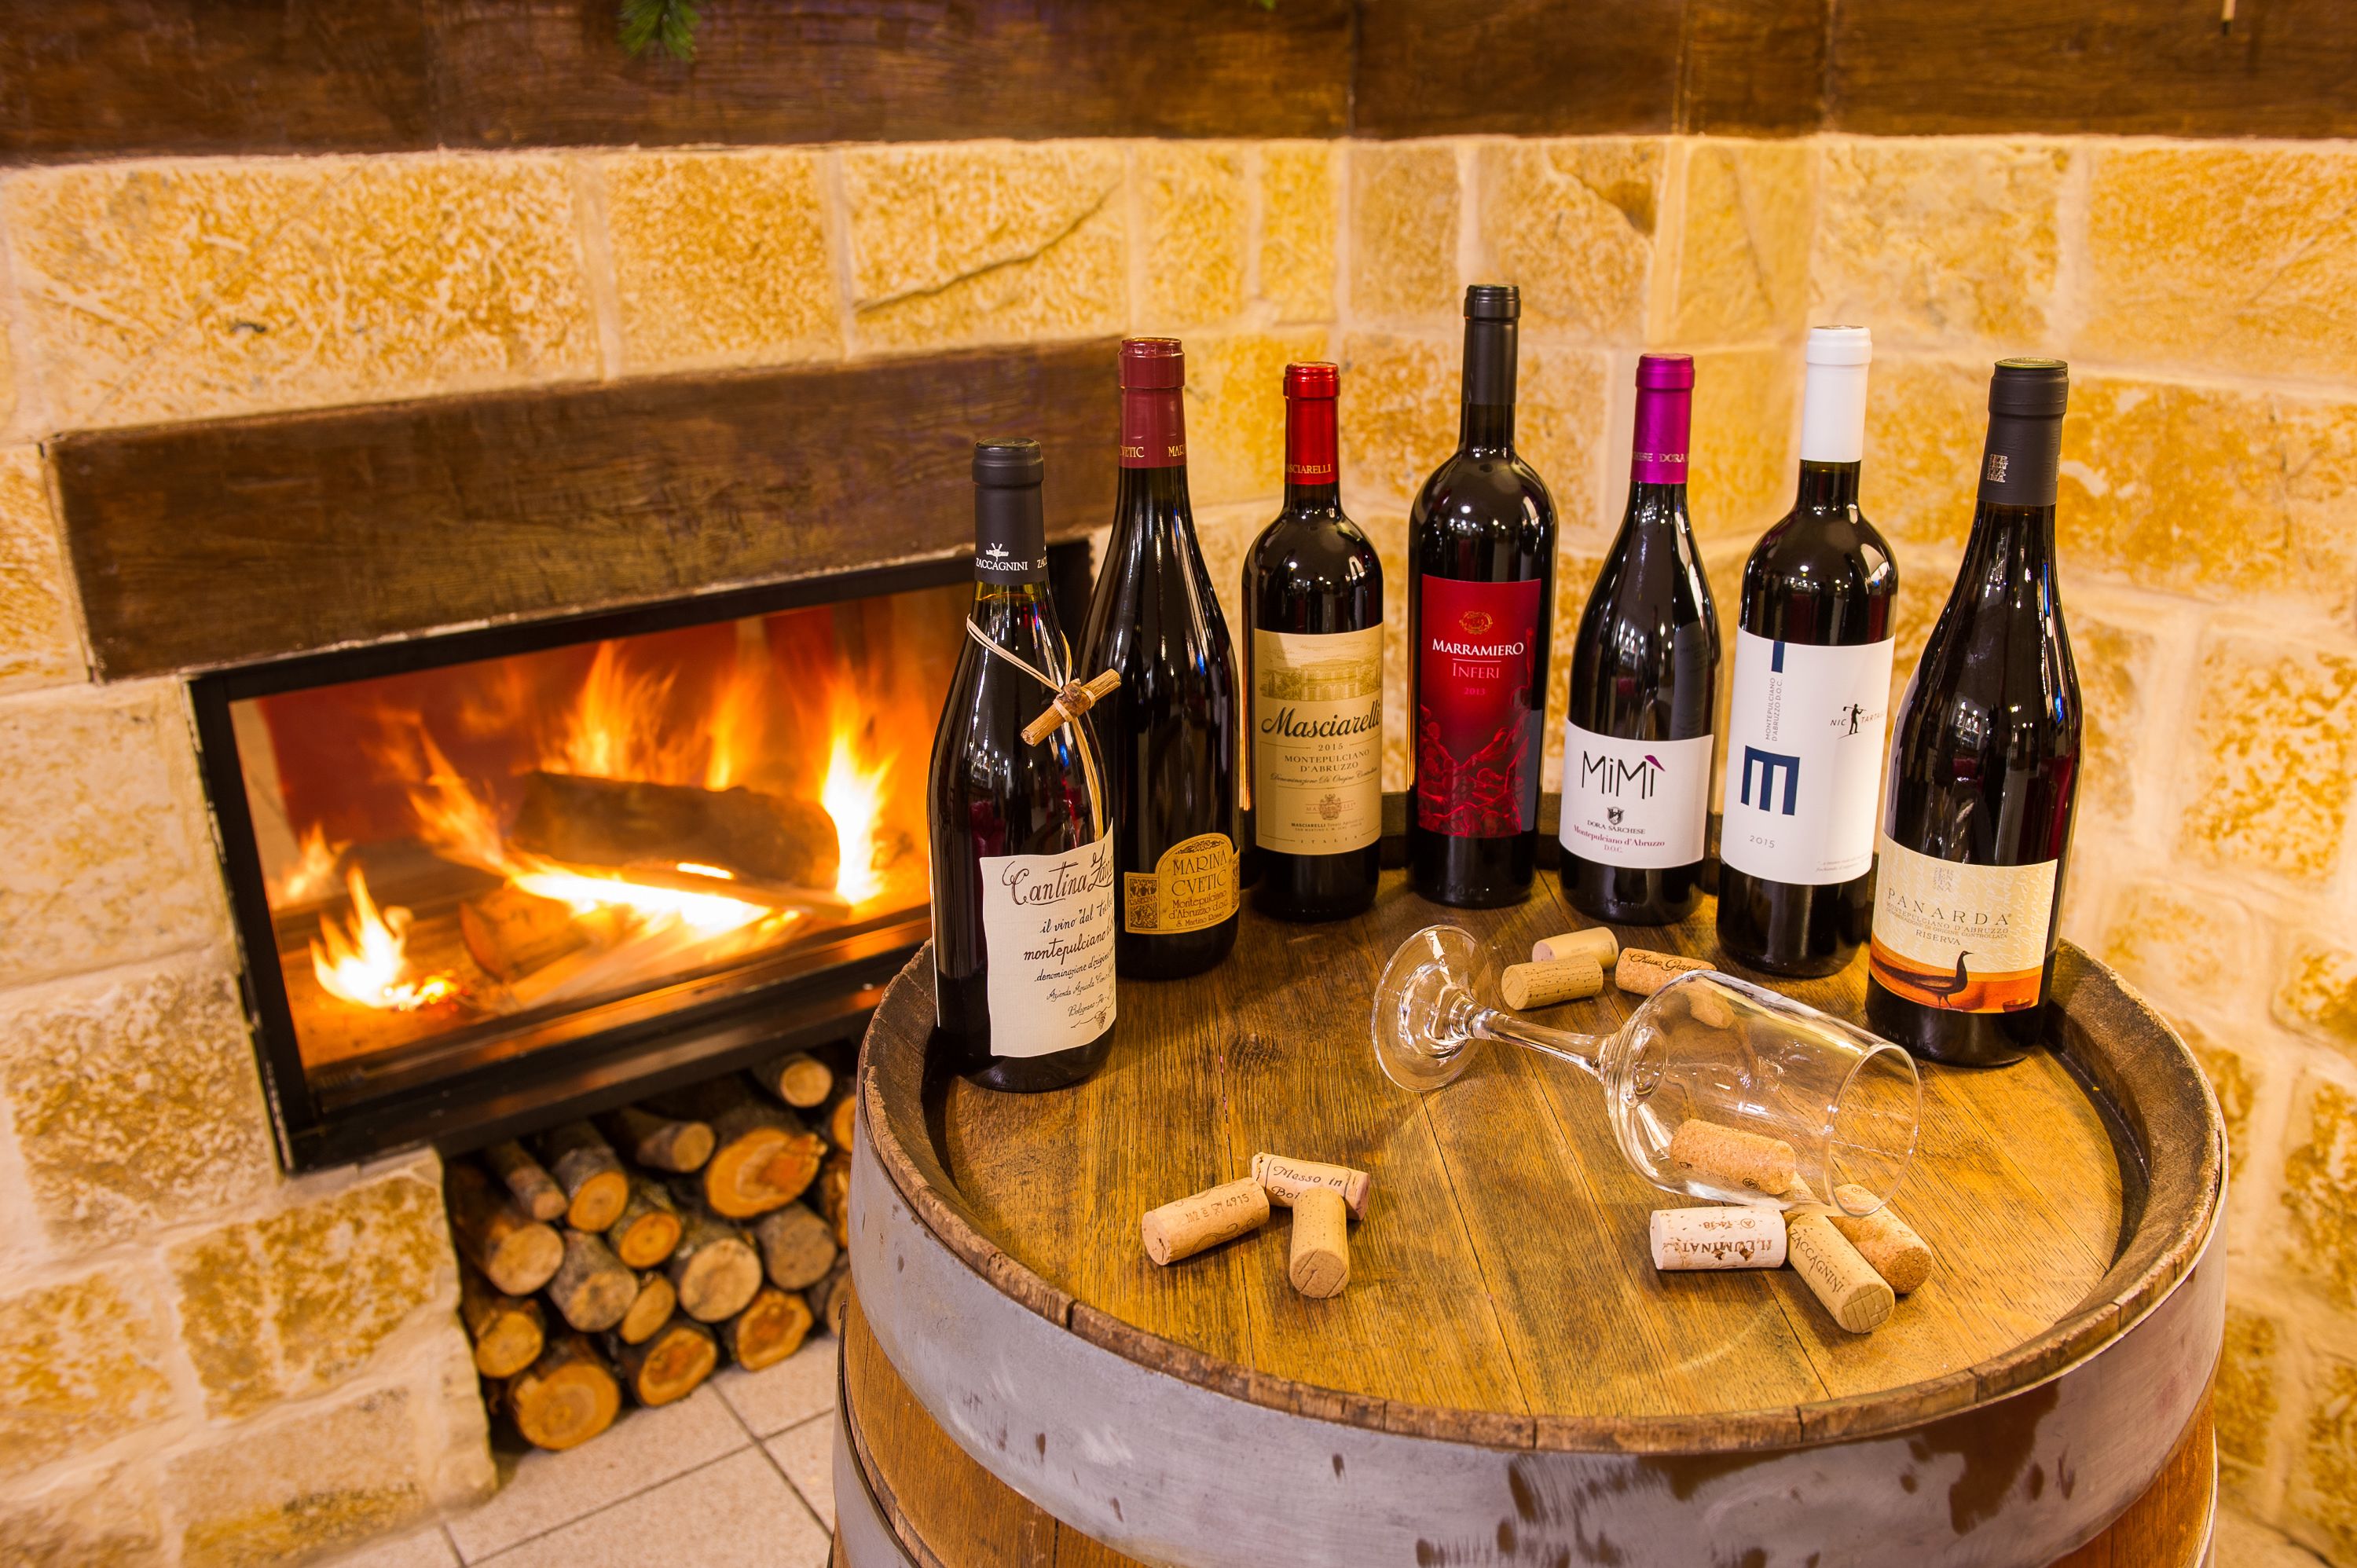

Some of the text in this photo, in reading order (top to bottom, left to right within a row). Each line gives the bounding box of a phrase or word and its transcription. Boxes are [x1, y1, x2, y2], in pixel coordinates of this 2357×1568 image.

[1659, 453, 1684, 463] DORA
[976, 557, 1028, 571] ZACCAGNINI
[1432, 638, 1524, 656] MARRAMIERO
[1453, 662, 1499, 679] INFERI
[1765, 677, 1776, 741] MONTEPULCIANO
[1261, 699, 1381, 738] Masciarelli
[1772, 702, 1781, 742] D'ABRUZZO
[1285, 749, 1369, 763] MONTEPULCIANO
[1300, 761, 1358, 773] D'ABRUZZO
[1587, 819, 1646, 834] DORA SARCHESE
[1574, 824, 1665, 847] Montepulciano d'Abruzzo
[1749, 834, 1776, 848] 2015
[1172, 850, 1227, 876] MARINA
[1002, 861, 1088, 905] Cantina
[1172, 890, 1226, 909] Montepulciano
[1888, 888, 2009, 925] PANARDA
[1169, 906, 1211, 920] d'Abruzzo
[1185, 917, 1207, 926] Martino
[1887, 902, 2009, 935] MONTEPULCIANO D'ABRUZZO
[1039, 919, 1051, 933] il
[1054, 919, 1076, 932] vino
[1915, 929, 1961, 946] RISERVA
[1961, 931, 2008, 940] CONTROLLATA
[1024, 933, 1105, 965] montepulciano
[1274, 1166, 1343, 1187] Messo in
[1226, 1193, 1250, 1207] 4915
[1791, 1228, 1844, 1293] ZACCAGNINI
